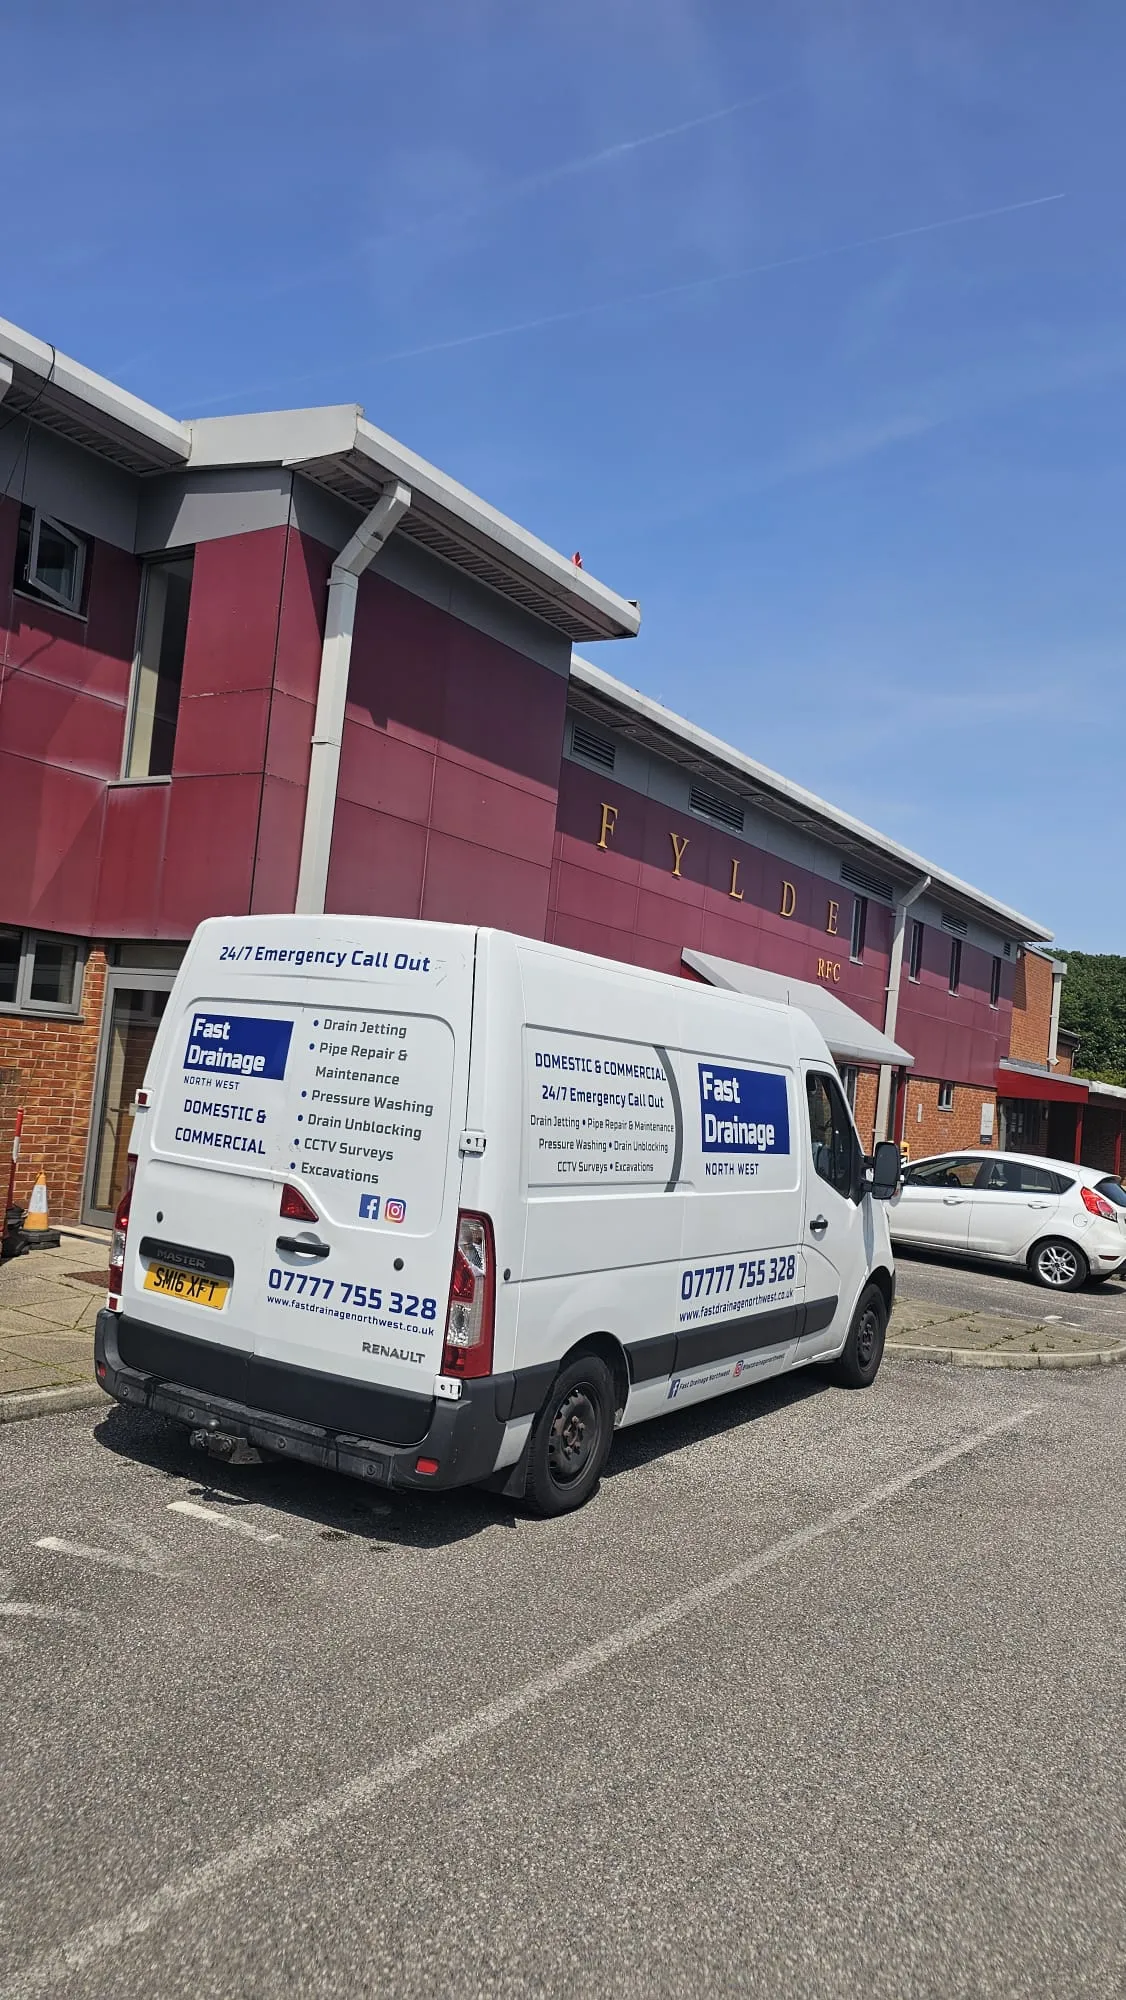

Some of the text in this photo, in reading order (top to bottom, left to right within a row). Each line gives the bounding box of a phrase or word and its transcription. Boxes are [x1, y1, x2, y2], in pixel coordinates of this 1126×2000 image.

[597, 802, 839, 934] FYLDE
[220, 946, 430, 972] 24/7 Emergency Call Out
[817, 958, 841, 981] RFC
[192, 1018, 230, 1040] Fast
[323, 1018, 407, 1038] Drain Jetting
[187, 1045, 265, 1074] Drainage
[319, 1042, 408, 1061] Pipe Repair &
[315, 1066, 400, 1085] Maintenance
[535, 1052, 666, 1080] DOMESTIC & COMMERCIAL
[184, 1076, 240, 1090] NORTH WEST
[702, 1071, 740, 1104] Fast
[312, 1090, 433, 1116] Pressure Washing
[542, 1085, 664, 1108] 24/7 Emergency Call Out
[184, 1099, 267, 1124] DOMESTIC &
[530, 1115, 674, 1132] Drain Jetting Pipe Repair & Maintenance
[308, 1114, 422, 1140] Drain Unblocking
[704, 1114, 775, 1151] Drainage
[175, 1128, 266, 1155] COMMERCIAL
[304, 1138, 393, 1161] CCTV Surveys
[539, 1139, 668, 1153] Pressure Washing Drain Unblocking
[301, 1162, 379, 1184] Excavations
[558, 1161, 654, 1173] CCTV Surveys Excavations
[705, 1163, 759, 1175] NORTH WEST
[157, 1249, 205, 1268] MASTER
[154, 1268, 218, 1301] SM16 XFT
[681, 1255, 795, 1300] 07777 755 328
[269, 1269, 437, 1320] 07777 755 328
[680, 1288, 793, 1322] www.fastdrainagenorthwest.co.uk
[267, 1294, 434, 1336] www.fastdrainagenorthwest.co.uk
[362, 1341, 425, 1364] RENAULT
